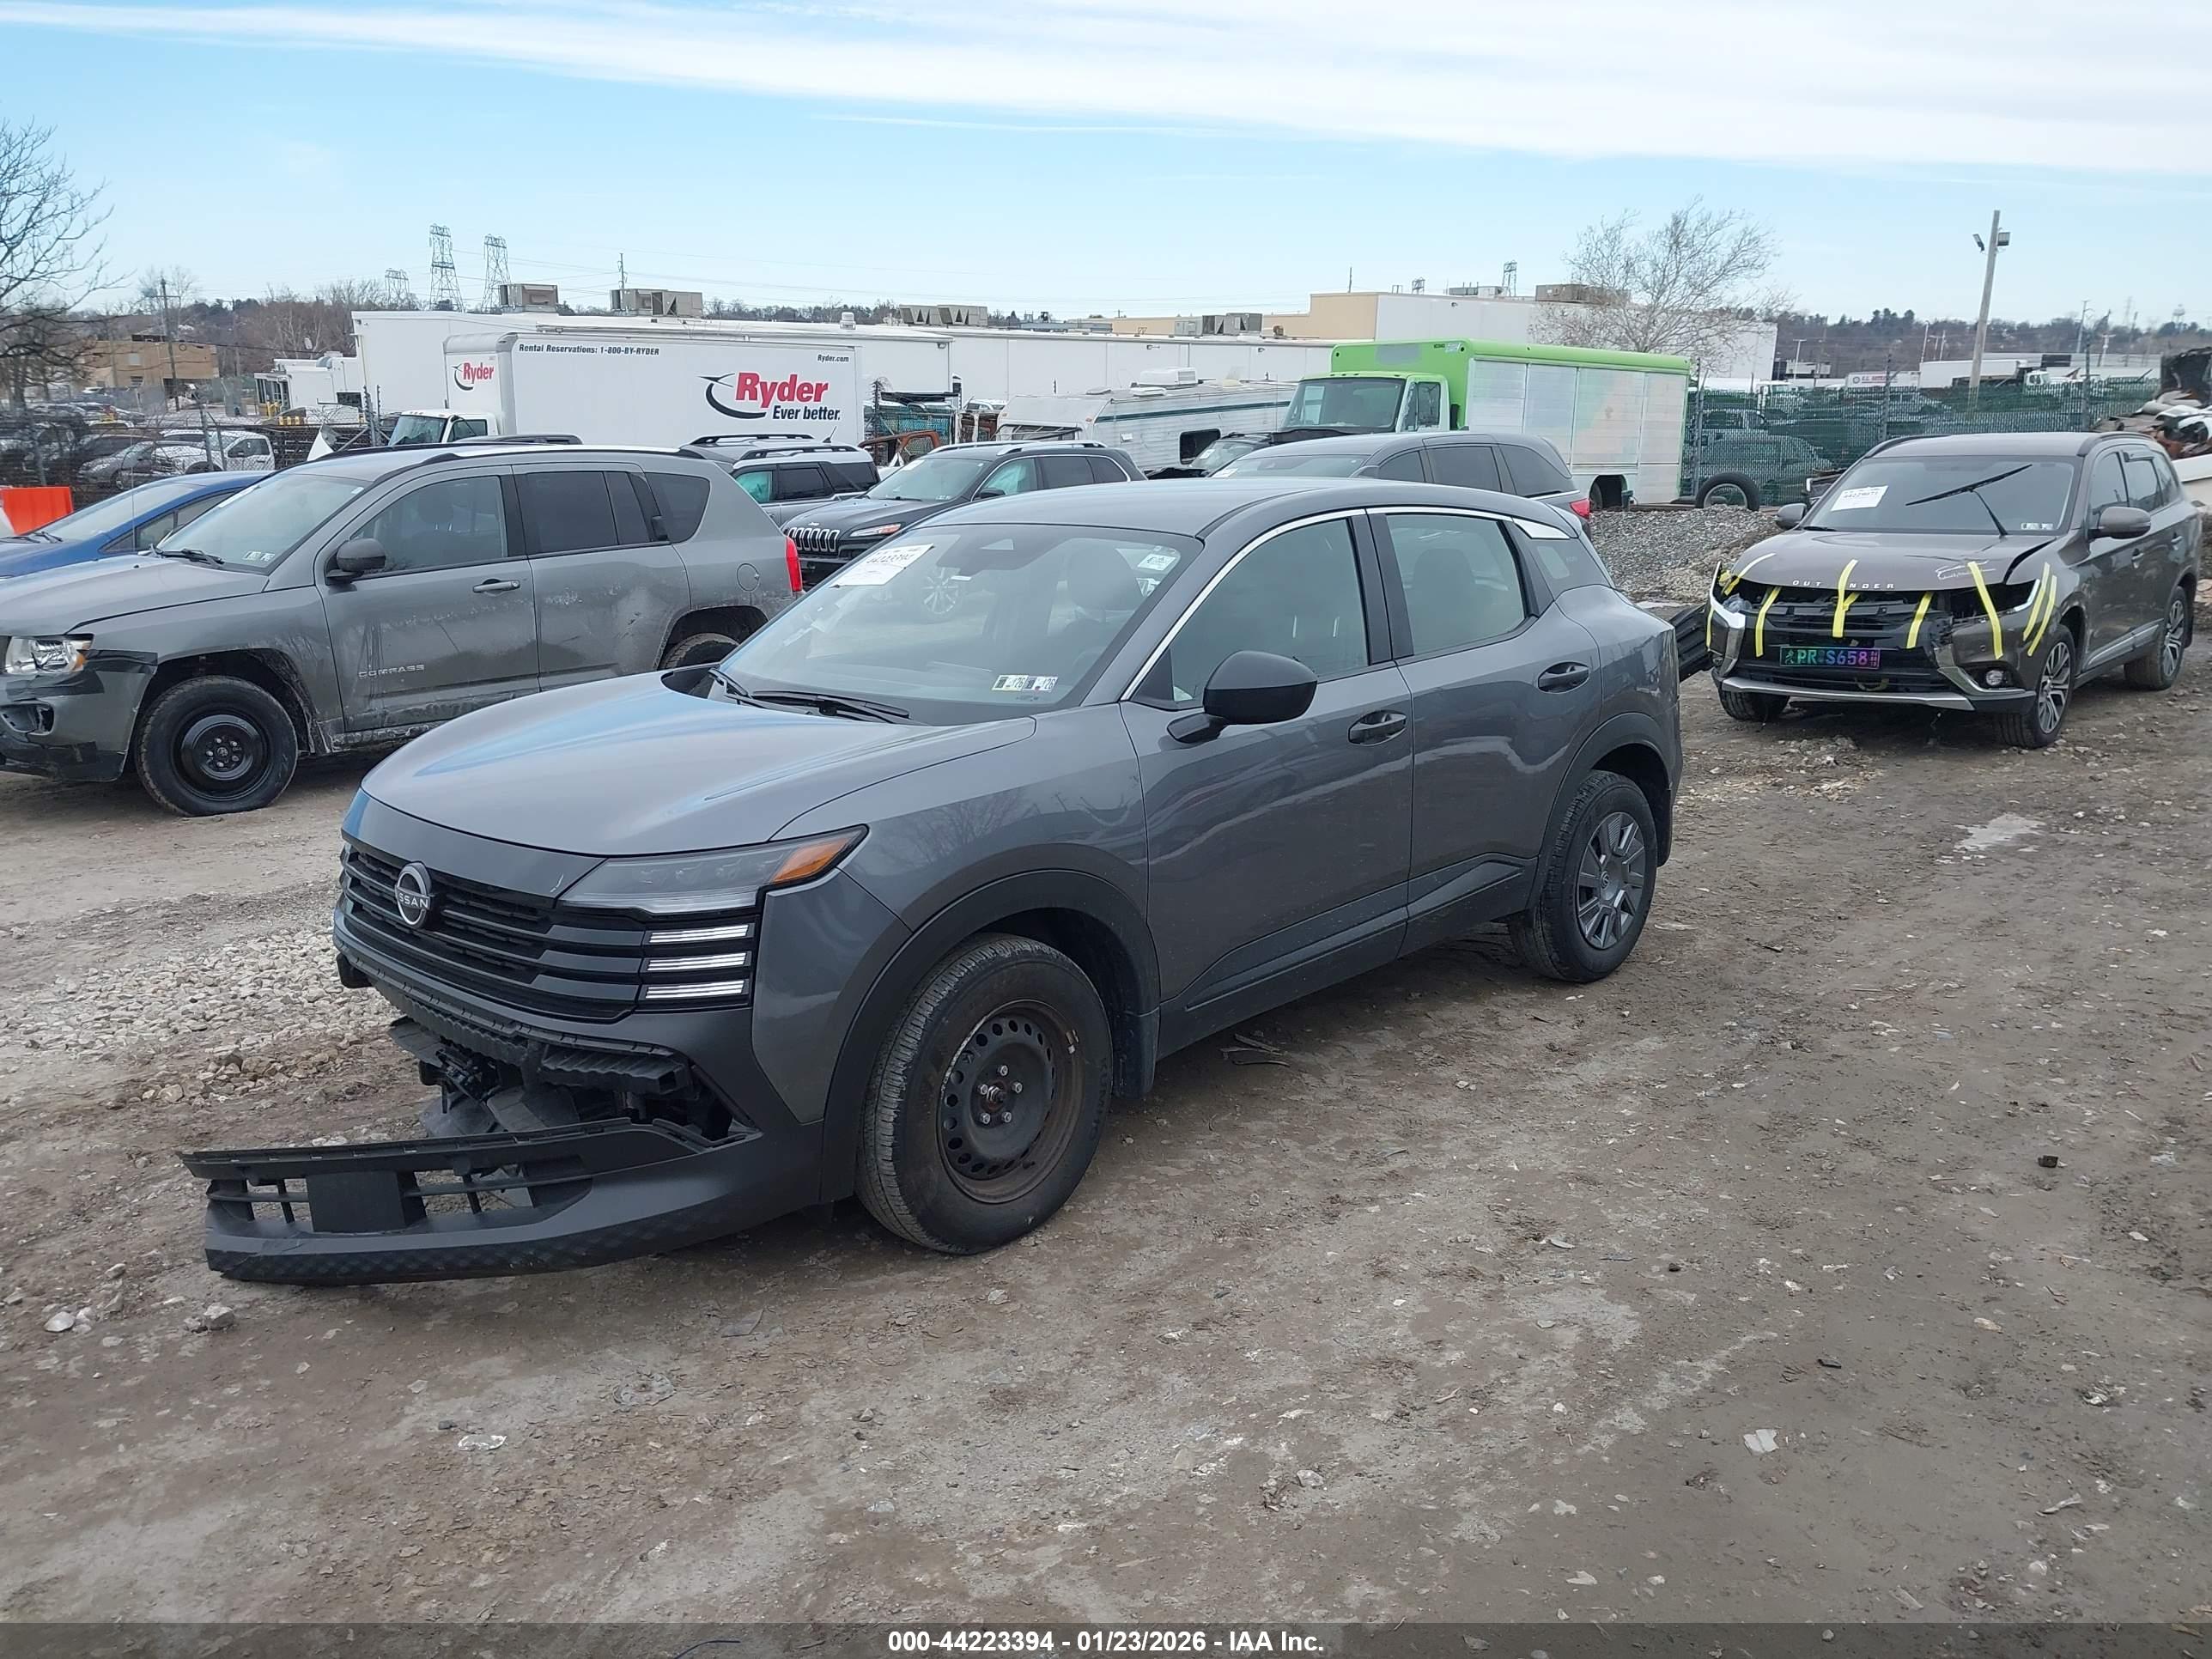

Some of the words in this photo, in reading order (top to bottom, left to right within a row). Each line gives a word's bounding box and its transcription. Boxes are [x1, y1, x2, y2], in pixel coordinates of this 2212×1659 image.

[519, 343, 544, 352] Rental
[546, 344, 598, 354] Reservations:
[599, 346, 659, 356] 1-800-BY-RYDER
[817, 354, 849, 363] Ryder.com
[463, 362, 495, 384] Ryder
[735, 372, 830, 409] Ryder
[773, 404, 801, 420] Ever
[803, 405, 841, 421] better.
[1792, 580, 1894, 589] OUTNDER
[357, 664, 425, 678] COMPASS
